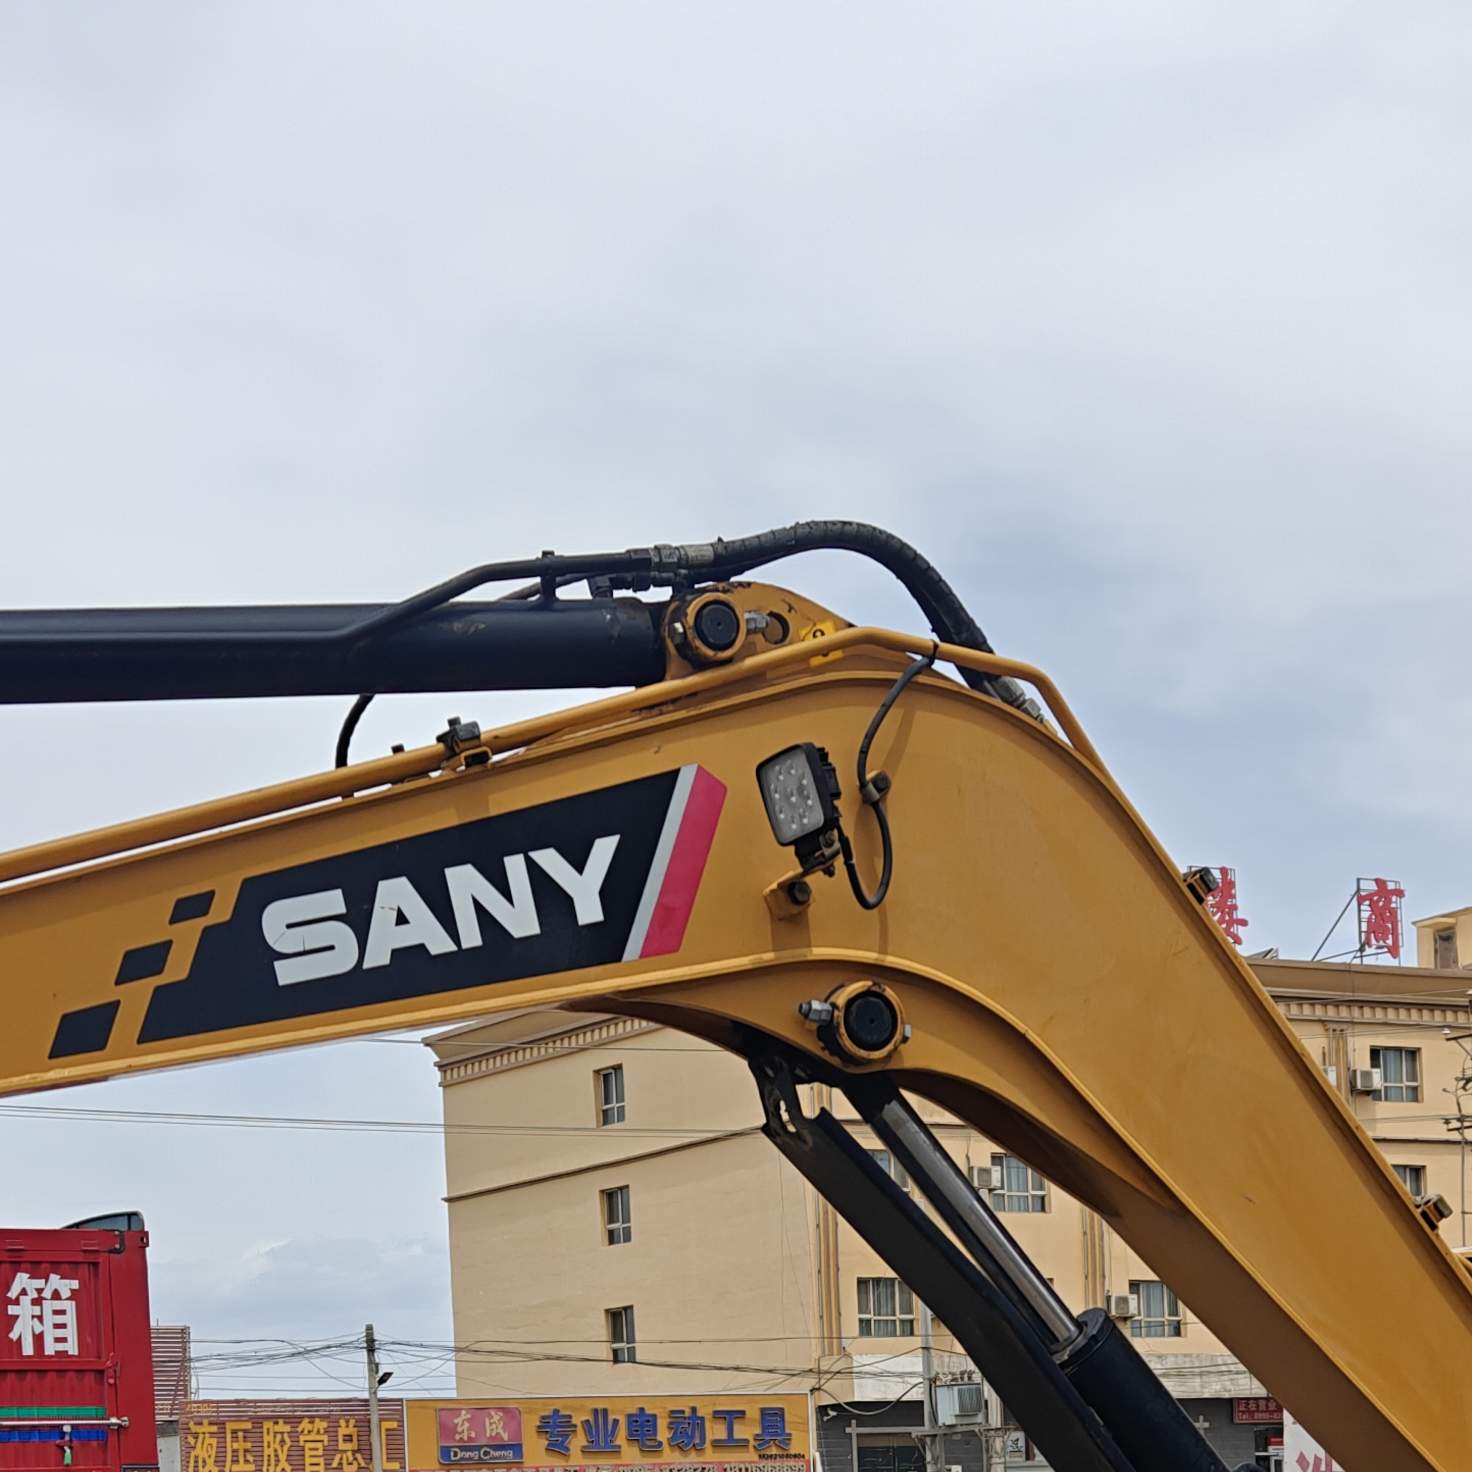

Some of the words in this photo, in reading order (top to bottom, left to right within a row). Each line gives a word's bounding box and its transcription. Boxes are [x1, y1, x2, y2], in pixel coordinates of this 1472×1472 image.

[262, 834, 621, 987] SANY
[452, 1409, 509, 1442] 东成
[535, 1406, 793, 1456] 专业电动工具
